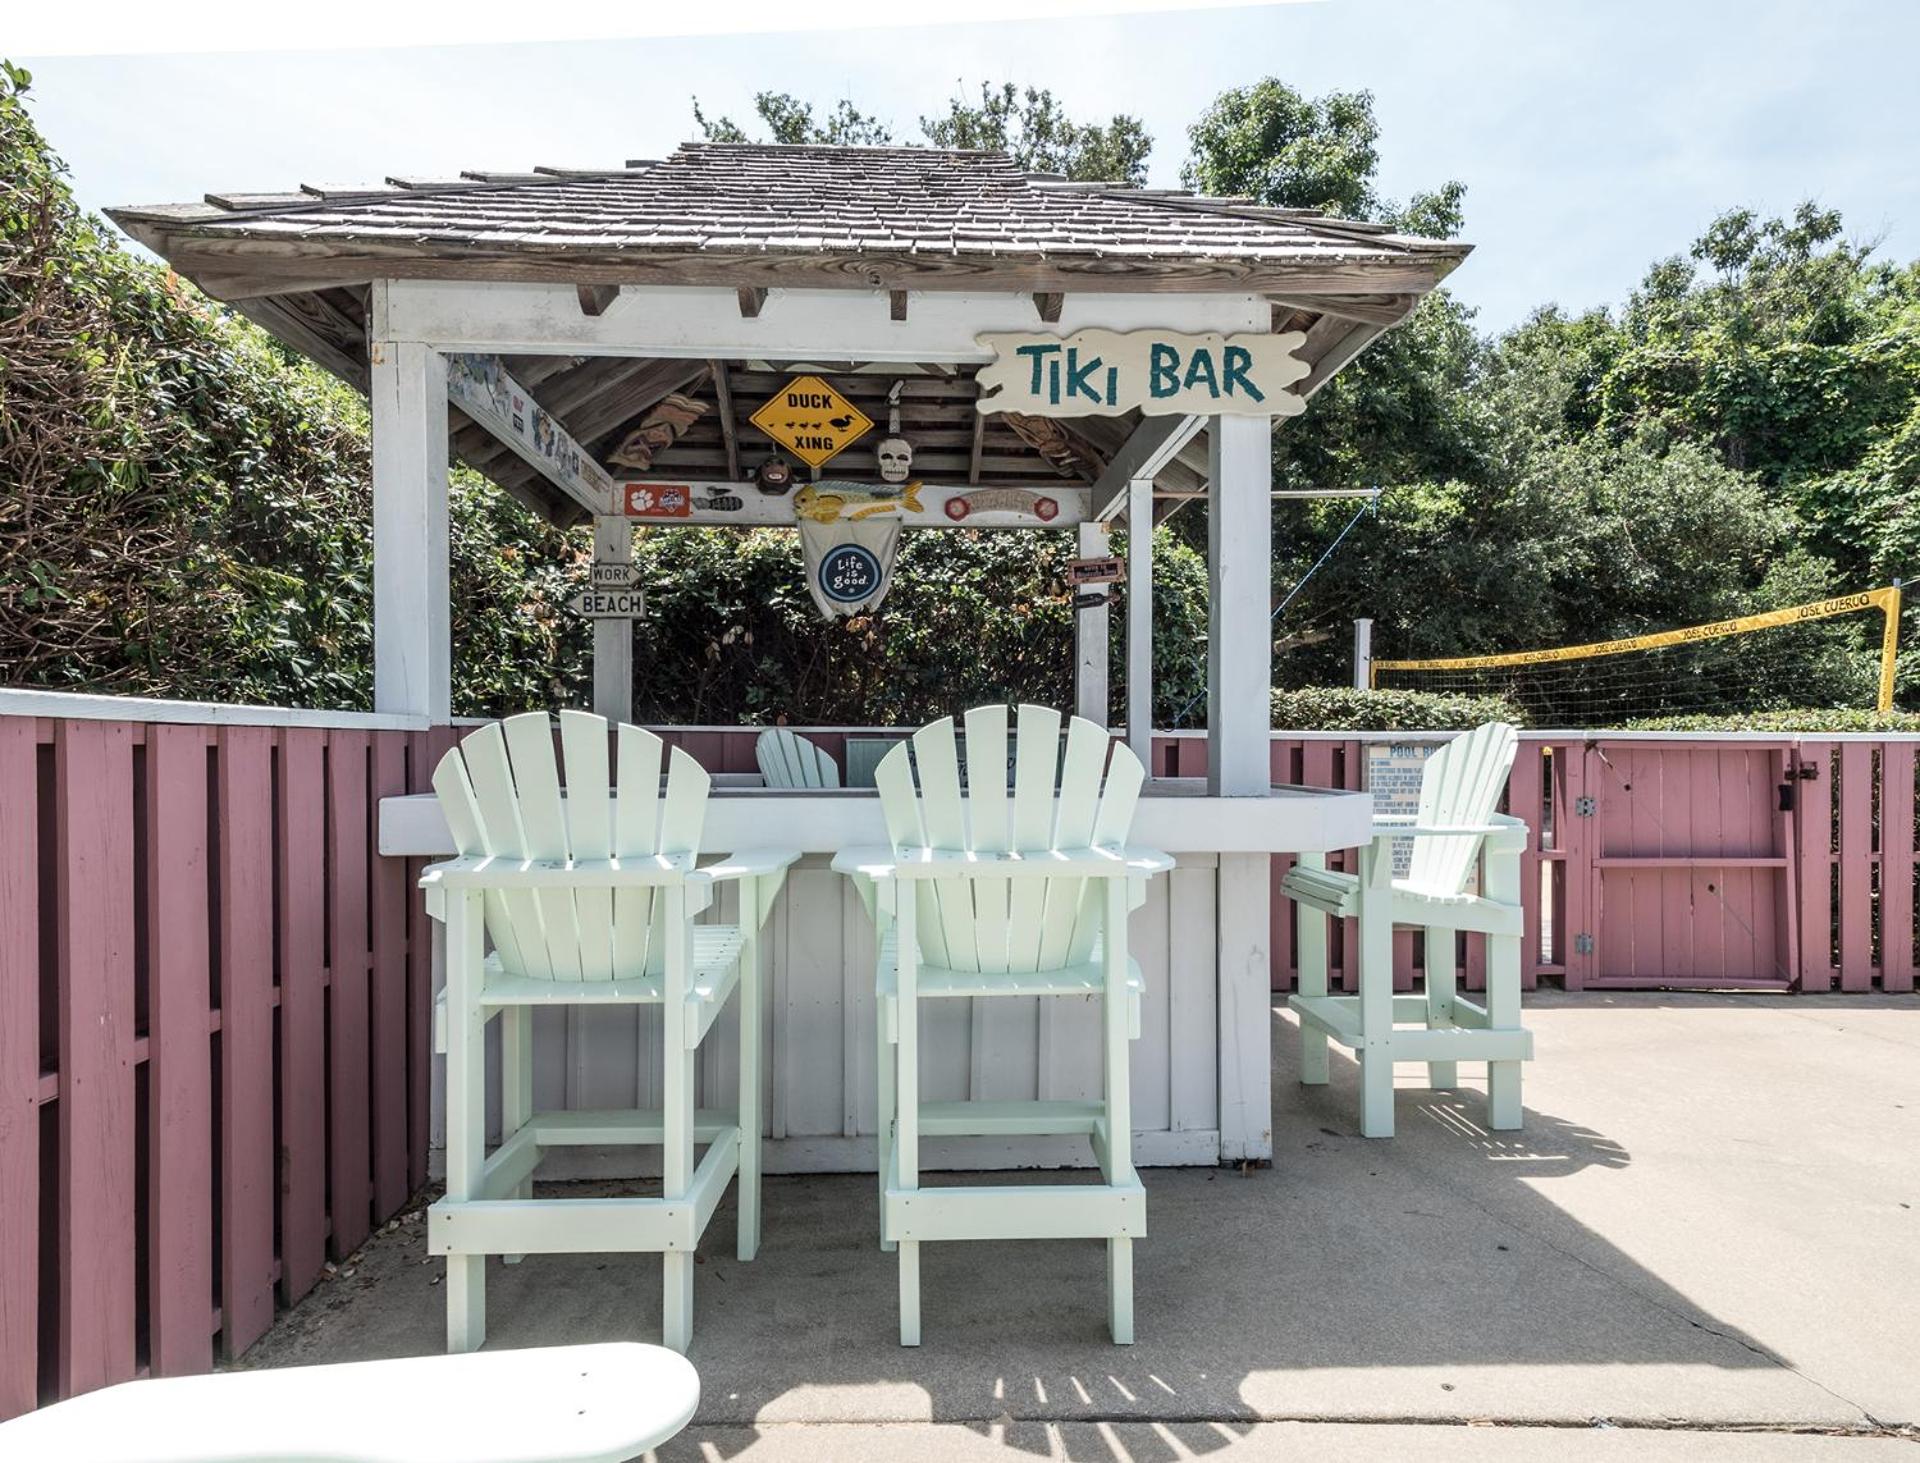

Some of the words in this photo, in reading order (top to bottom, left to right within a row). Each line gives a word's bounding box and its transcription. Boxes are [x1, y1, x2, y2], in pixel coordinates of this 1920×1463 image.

[1016, 344, 1118, 406] TIKI
[1150, 343, 1266, 403] BAR
[788, 393, 833, 409] DUCK
[795, 436, 834, 450] XING
[837, 556, 863, 570] Life
[593, 568, 630, 580] WORK
[846, 569, 858, 577] is
[583, 596, 641, 612] BEACH
[1797, 604, 1821, 619] JOSE
[1390, 745, 1418, 758] POOL
